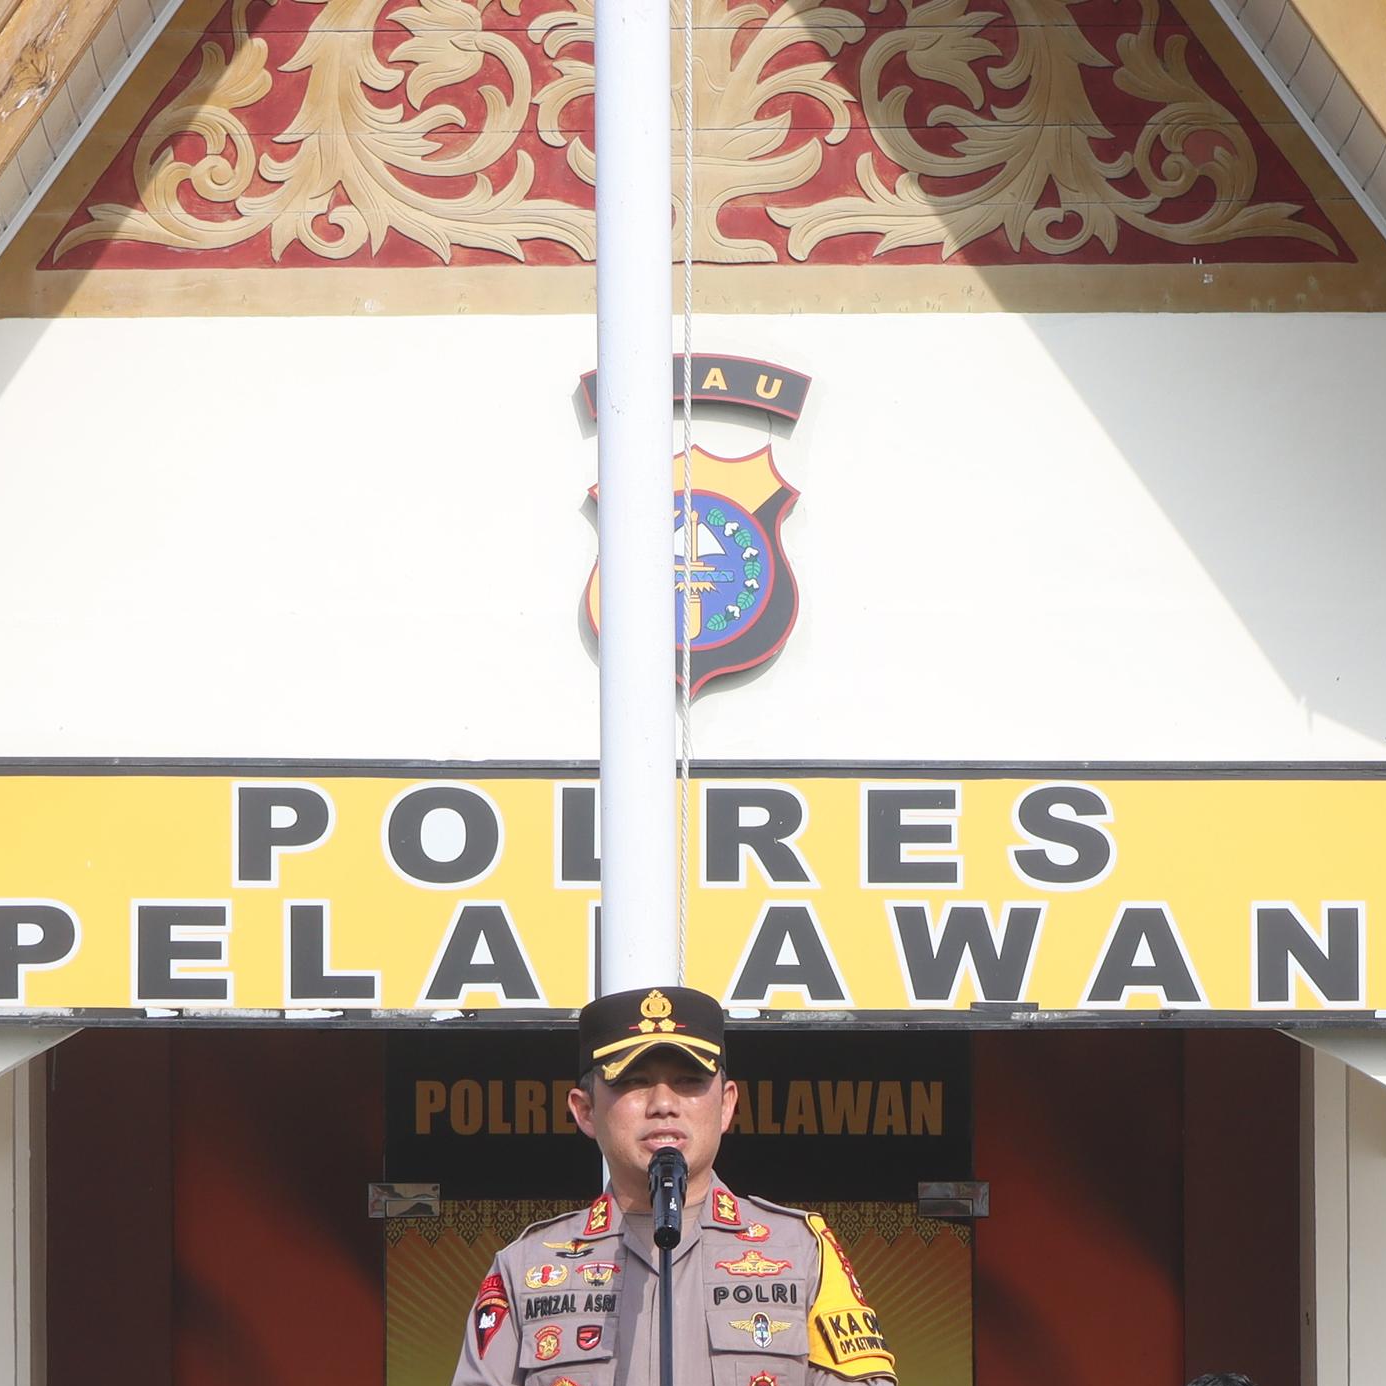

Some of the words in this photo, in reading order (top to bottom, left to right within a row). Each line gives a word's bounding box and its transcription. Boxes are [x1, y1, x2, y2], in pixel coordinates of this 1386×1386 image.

[415, 1079, 578, 1136] POLRE
[726, 1080, 943, 1136] ALAWAN
[525, 1294, 577, 1320] AFRIZAL
[713, 1283, 797, 1306] POLRI
[828, 1311, 863, 1340] KA
